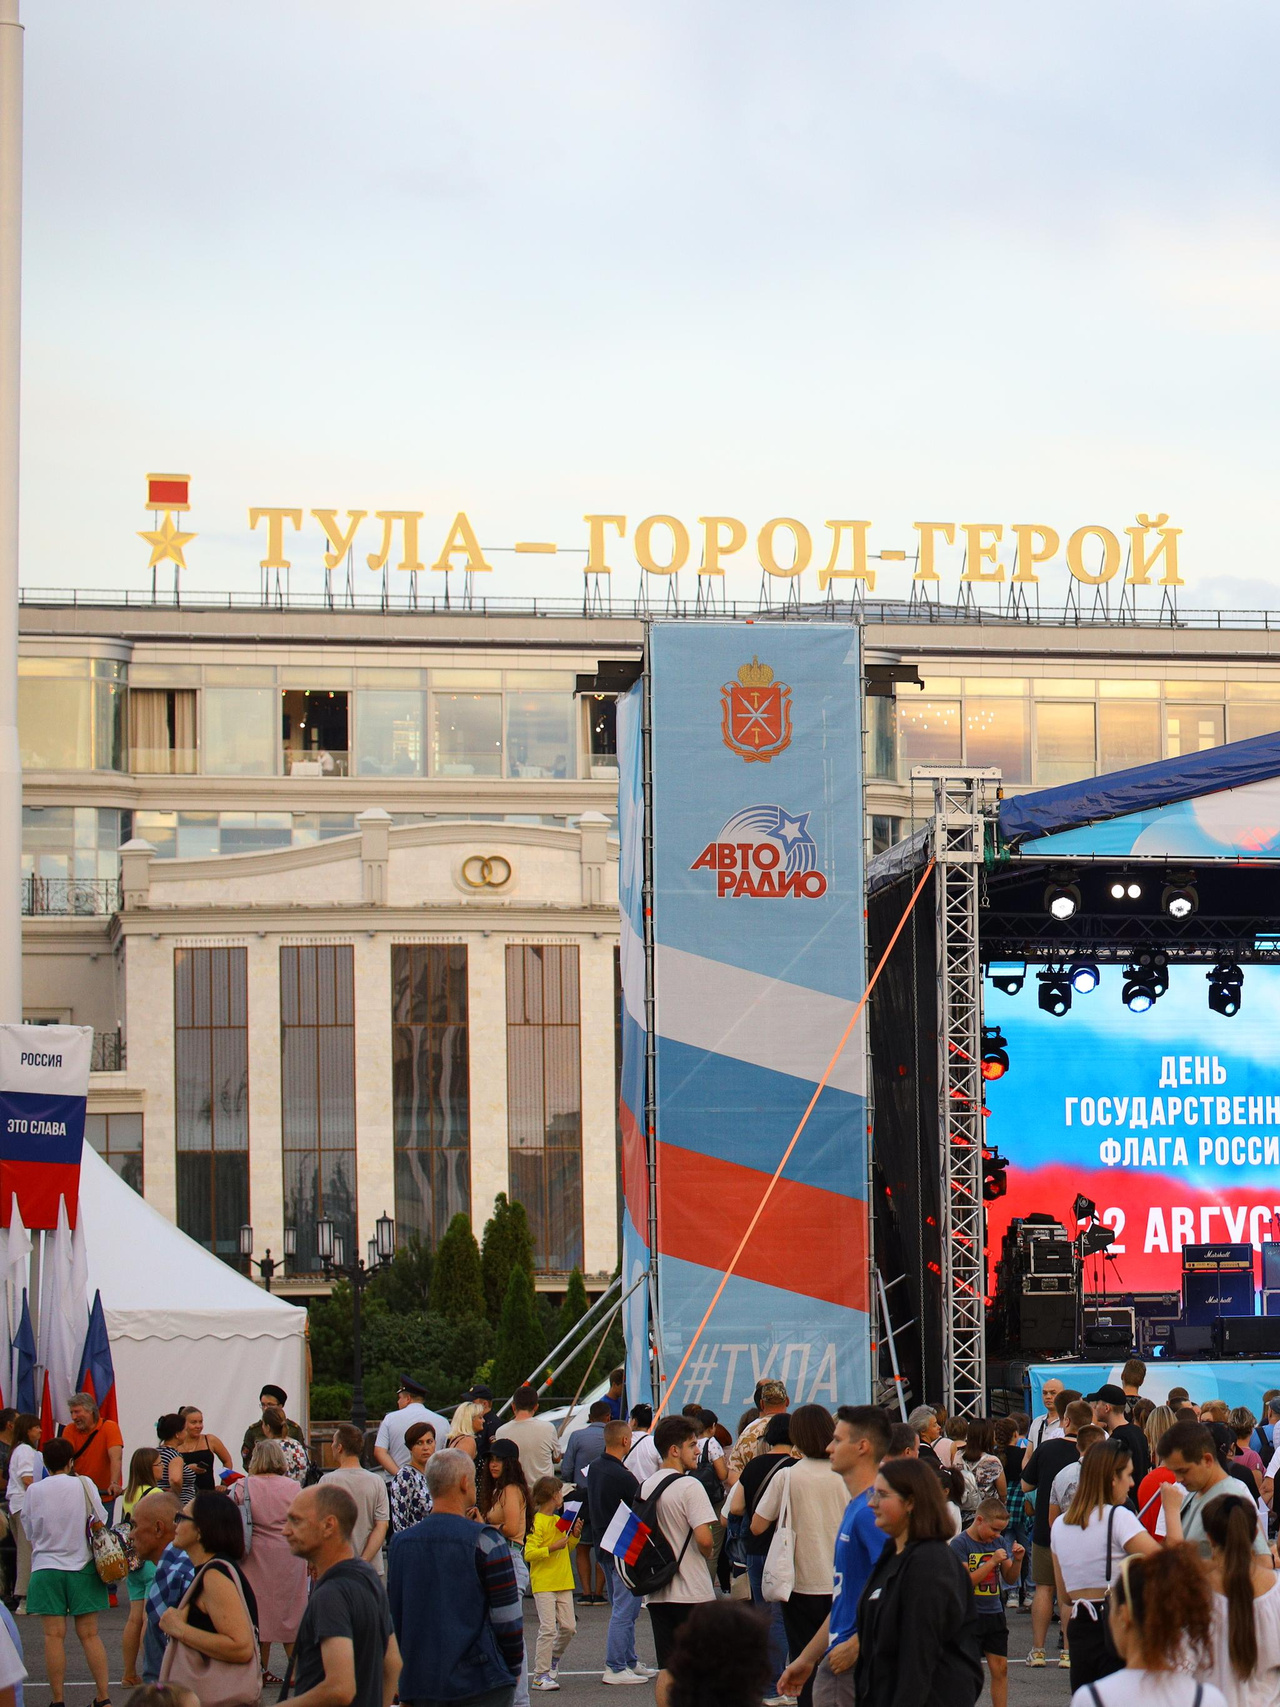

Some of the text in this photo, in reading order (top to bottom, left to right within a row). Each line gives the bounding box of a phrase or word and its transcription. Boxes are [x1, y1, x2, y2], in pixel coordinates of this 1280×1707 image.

[249, 507, 493, 573] ТУЛА
[583, 513, 1185, 592] ГОРОД-ГЕРОЙ
[689, 842, 781, 871] АВТО
[716, 870, 828, 899] РАДИО
[20, 1052, 63, 1068] РОССИЯ
[1158, 1055, 1227, 1089] ДЕНЬ
[7, 1118, 67, 1136] ЭТО СЛАВА
[1098, 1136, 1190, 1167] ФЛАГА
[1203, 1250, 1232, 1258] Marshall
[1204, 1296, 1233, 1304] Marhall
[682, 1343, 838, 1404] #ТУЛА
